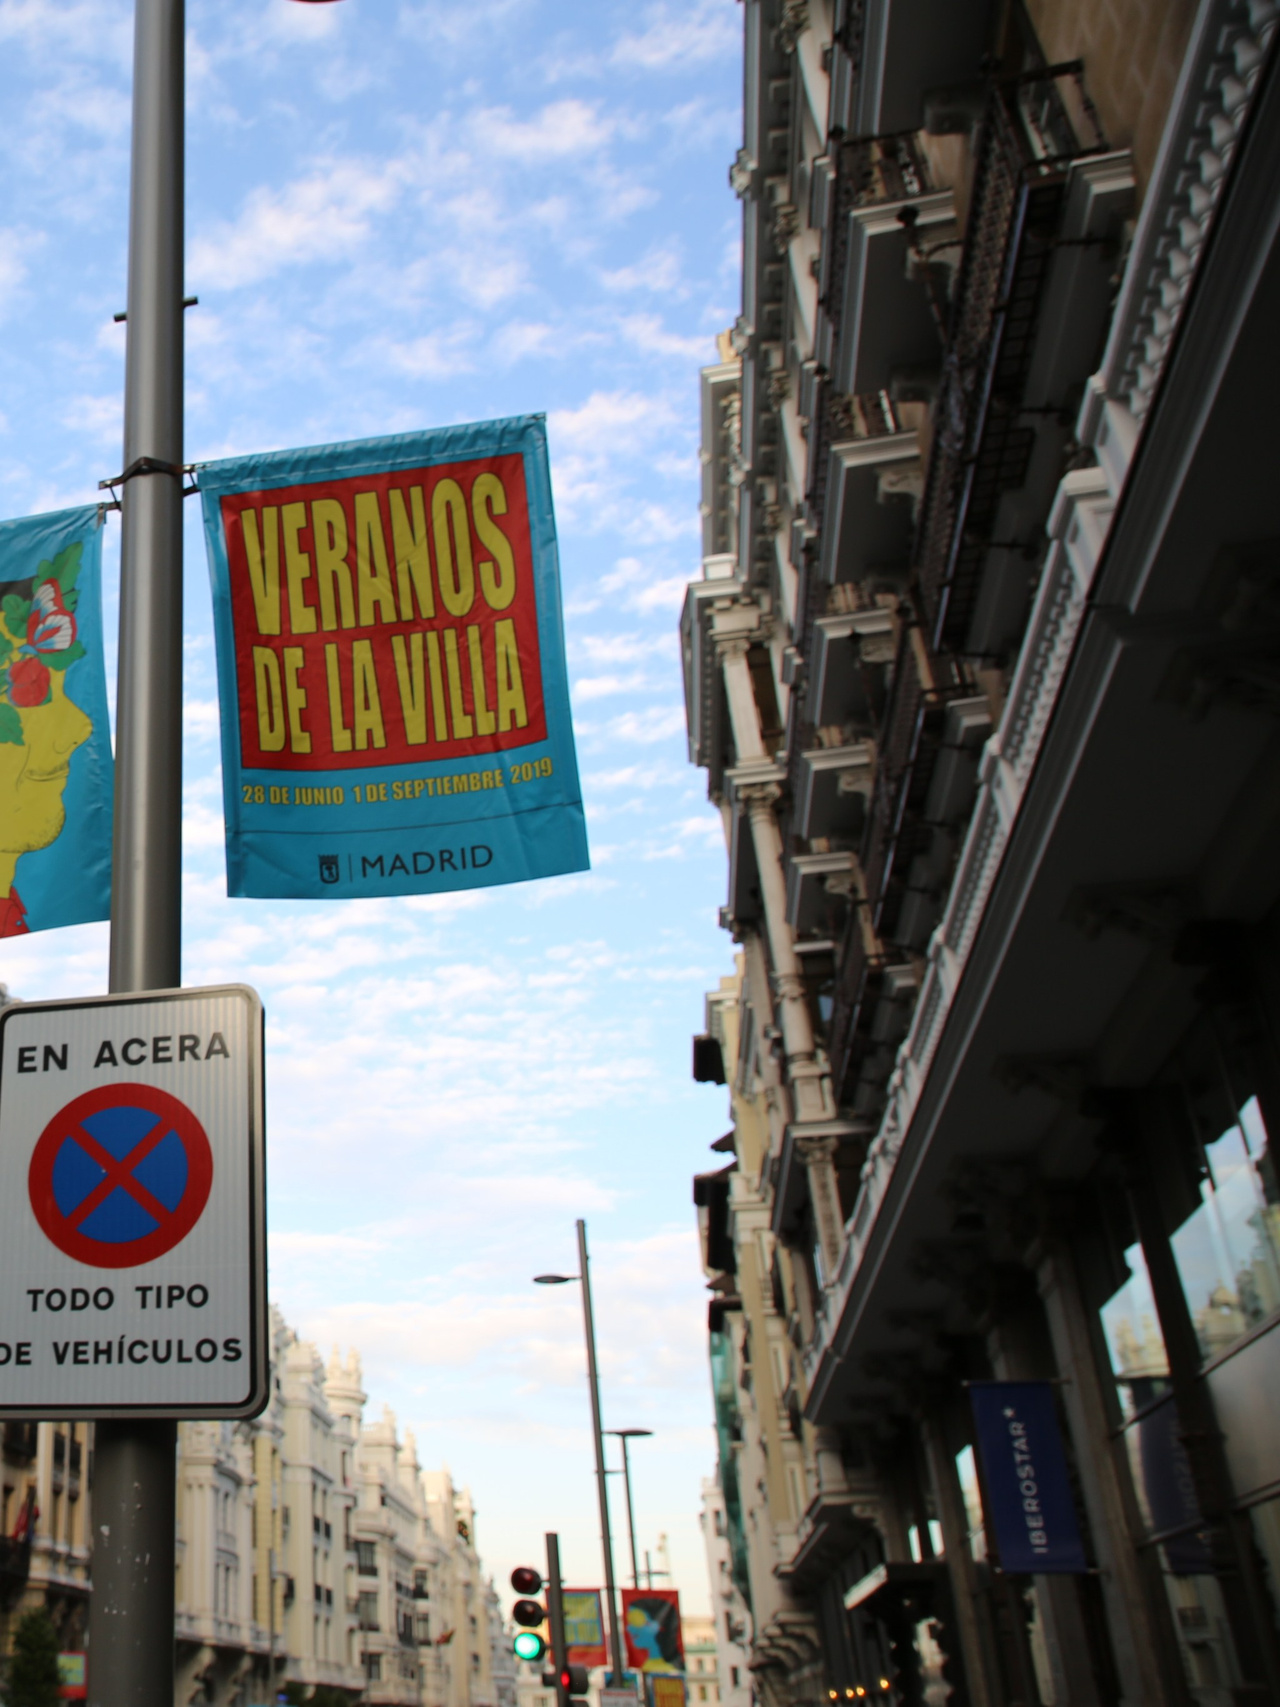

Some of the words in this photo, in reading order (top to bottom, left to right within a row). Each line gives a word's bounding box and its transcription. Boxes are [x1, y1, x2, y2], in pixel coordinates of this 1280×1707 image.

[241, 472, 517, 636] VERANOS
[252, 645, 312, 755] DE
[325, 639, 386, 753] LA
[391, 618, 529, 746] VILLA
[242, 785, 265, 804] 28
[270, 786, 290, 804] DE
[295, 786, 344, 805] JUNIO
[353, 786, 362, 803] 1
[366, 783, 388, 802] DE
[392, 768, 504, 800] SEPTIEMBRE
[510, 756, 553, 784] 2019
[361, 844, 493, 878] MADRID
[17, 1043, 69, 1074] EN
[93, 1032, 231, 1069] ACERA
[26, 1286, 115, 1312] TODO
[134, 1283, 209, 1310] TIPO
[52, 1334, 242, 1366] VEHÍCULOS
[1008, 1421, 1049, 1554] IBEROSTAR
